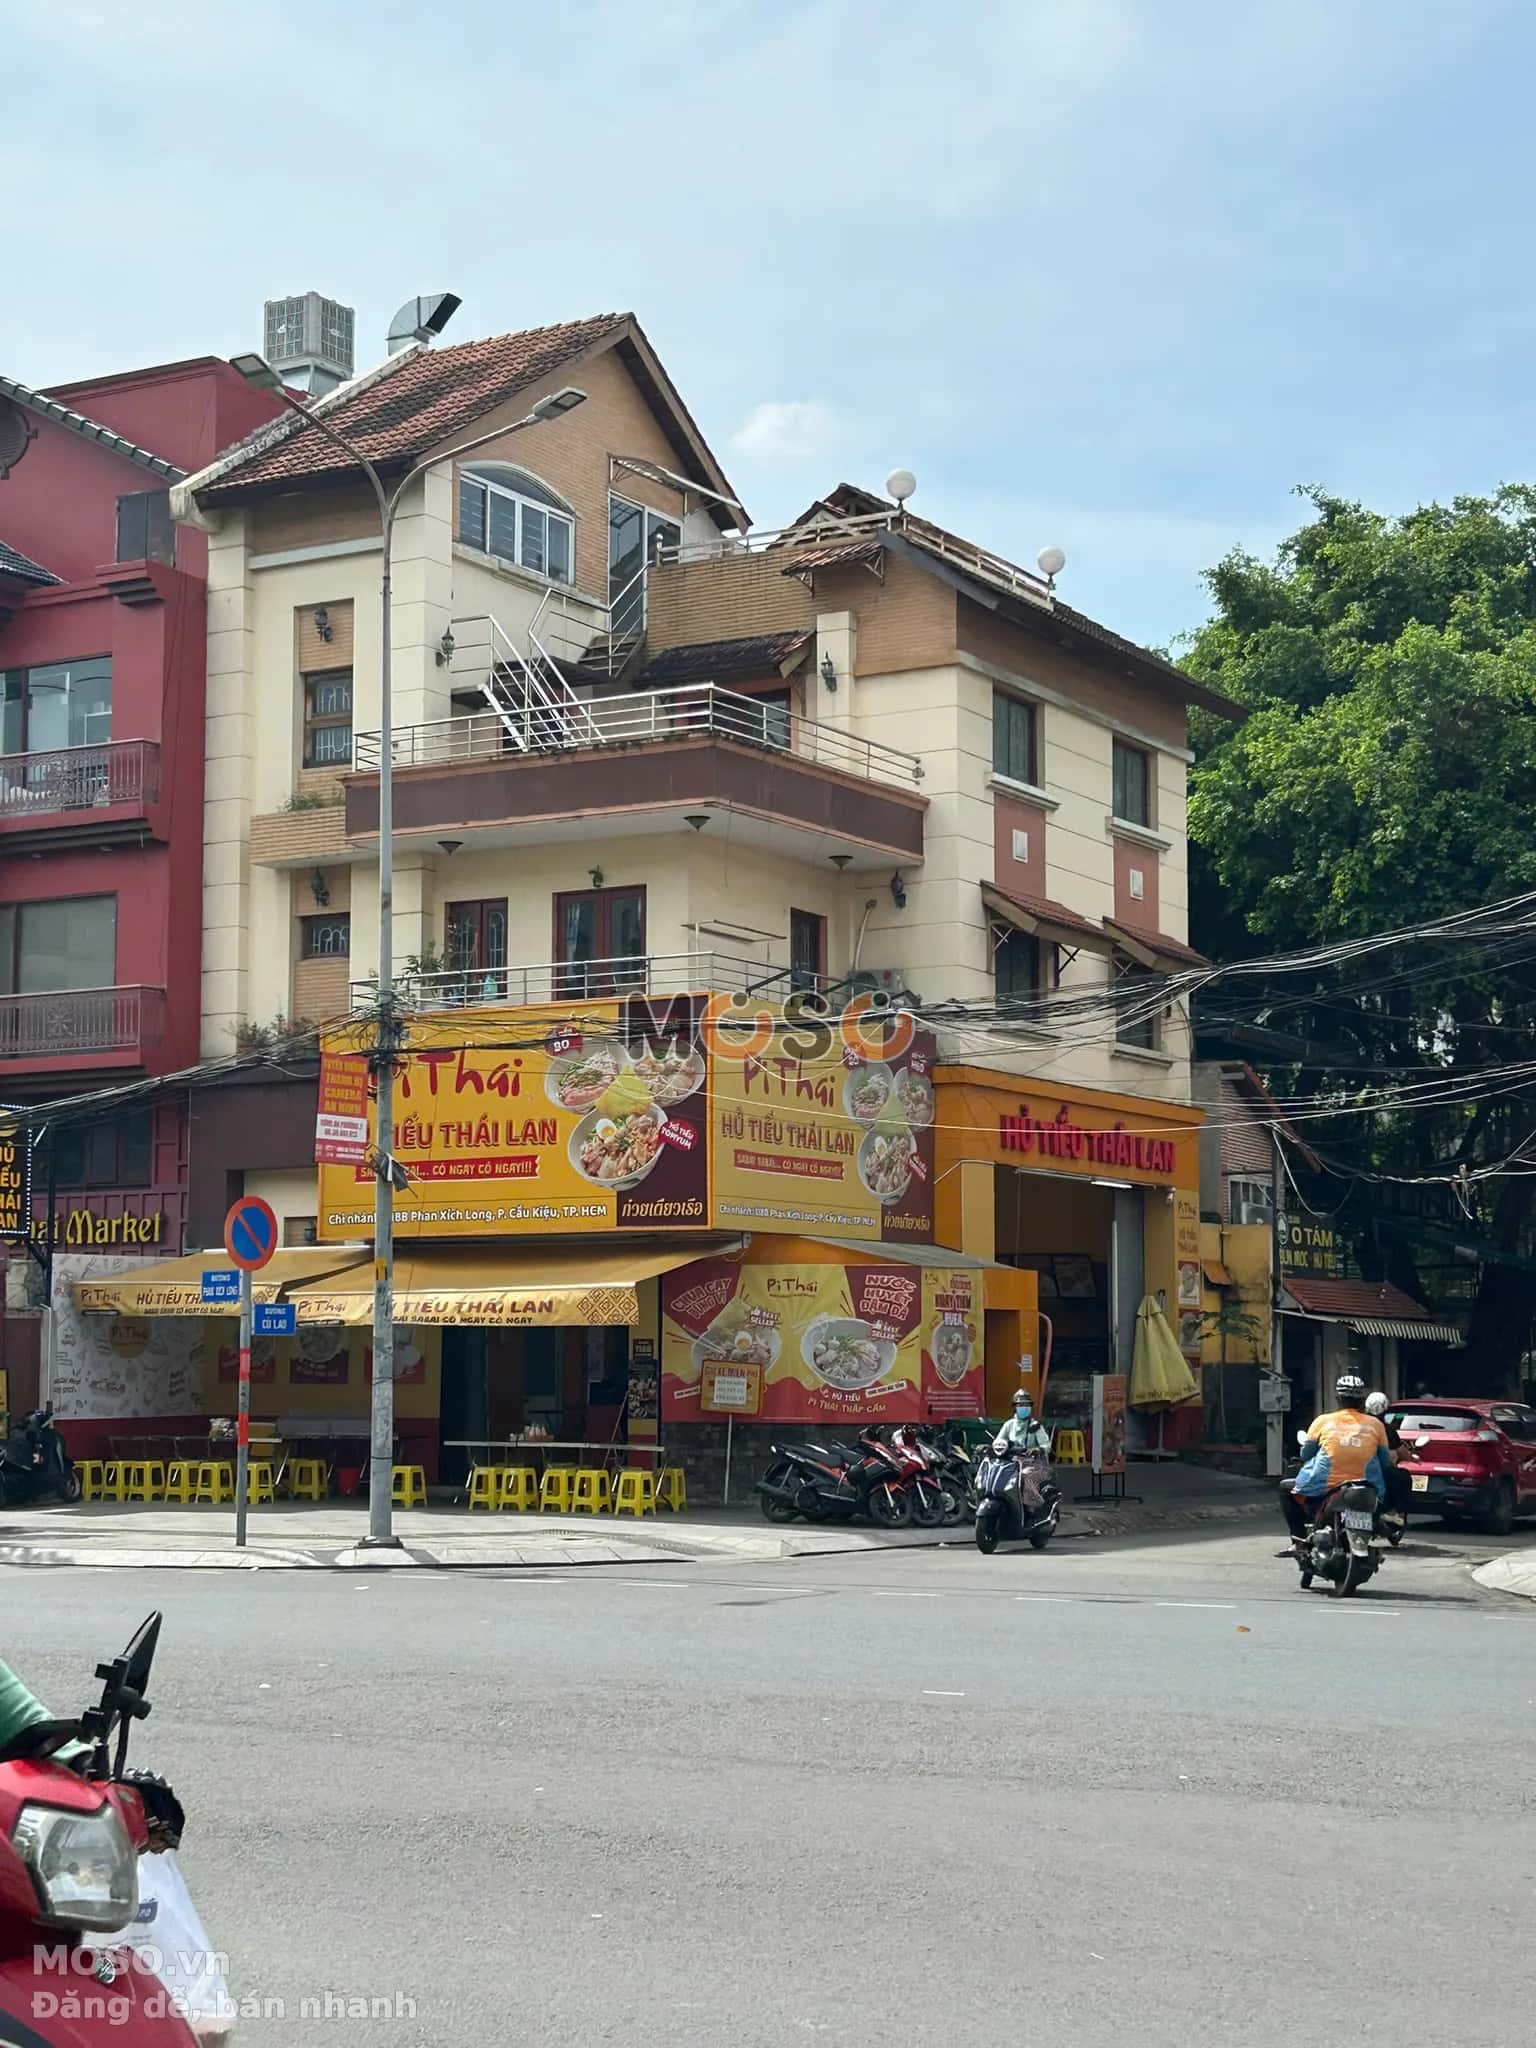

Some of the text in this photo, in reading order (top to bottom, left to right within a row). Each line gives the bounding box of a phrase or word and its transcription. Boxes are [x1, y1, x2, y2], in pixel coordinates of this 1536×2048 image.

[439, 1112, 500, 1148] THÁI
[506, 1118, 557, 1147] LAN
[721, 1106, 745, 1140] HỦ
[787, 1120, 822, 1151] THÁI
[825, 1129, 855, 1155] LAN
[1000, 1103, 1177, 1175] HỦ TIẾU THÁI LAN
[432, 1163, 446, 1176] CÓ
[449, 1164, 475, 1176] NGAY
[477, 1162, 492, 1175] CÓ
[328, 1214, 346, 1225] Chi
[410, 1210, 438, 1222] Phan
[440, 1208, 464, 1221] Xích
[465, 1209, 496, 1223] Long,
[497, 1209, 508, 1219] P.
[508, 1204, 530, 1219] Cầu
[562, 1206, 579, 1217] TP.
[65, 1209, 161, 1245] Market
[1291, 1225, 1334, 1248] O TÁM
[154, 1287, 181, 1305] TIẾU
[510, 1299, 556, 1314] LAN
[459, 1316, 487, 1325] NGAY
[505, 1316, 533, 1325] NGAY
